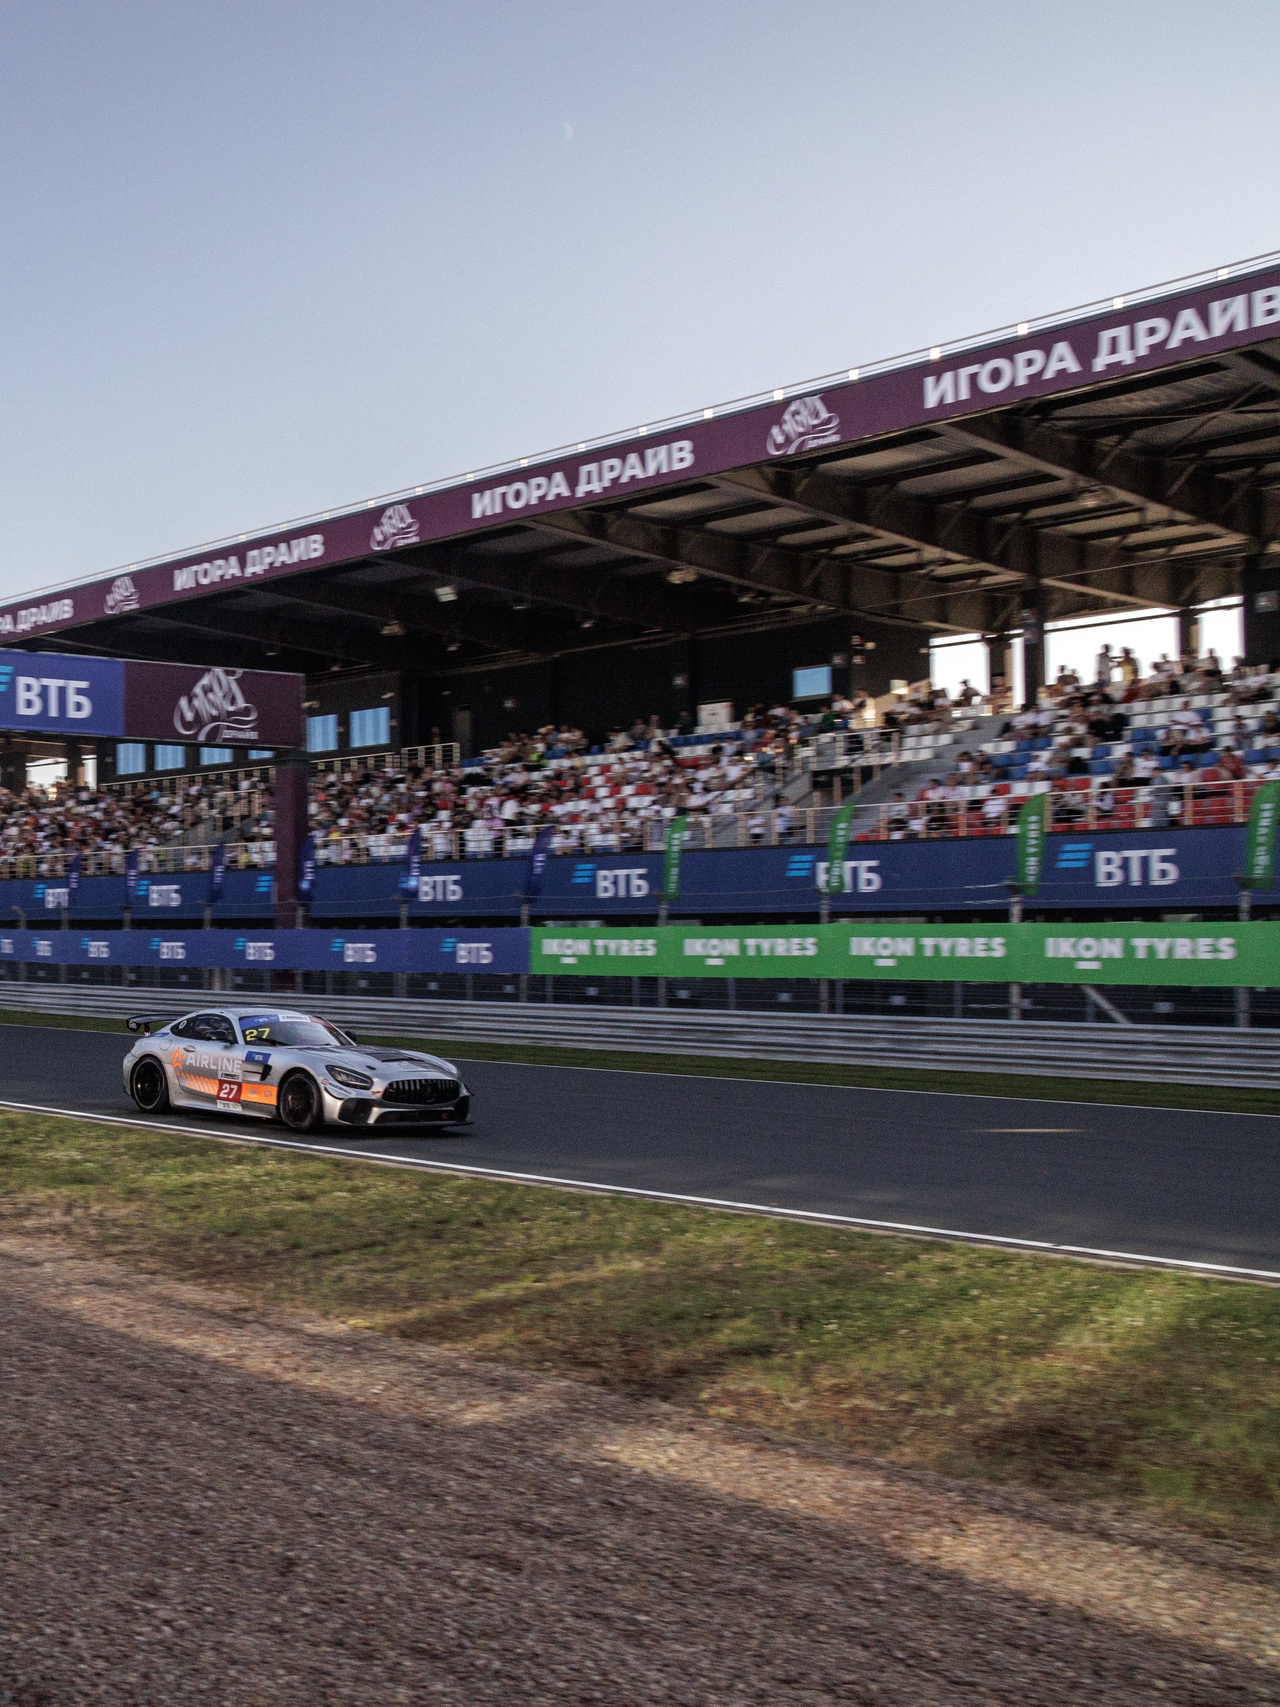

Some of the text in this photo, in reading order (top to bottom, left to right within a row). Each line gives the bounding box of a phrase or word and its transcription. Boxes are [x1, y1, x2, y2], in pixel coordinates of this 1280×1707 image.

[922, 341, 1083, 409] ИГОРА
[471, 471, 571, 519] ИГОРА
[173, 556, 242, 591] ИГОРА
[16, 677, 91, 718] ВТБ
[1096, 849, 1179, 886] ВТБ
[419, 875, 461, 901] ВТБ
[597, 869, 649, 898] ВТБ
[345, 944, 376, 962] ВТБ
[457, 943, 492, 963] ВТБ
[543, 939, 656, 956] IKON TYRES
[685, 938, 817, 955] IKON TYRES
[851, 937, 1006, 957] IKON TYRES
[1046, 938, 1235, 959] IKON TYRES
[245, 1028, 271, 1041] 27
[186, 1054, 243, 1073] AIRLINE
[220, 1083, 238, 1098] 27
